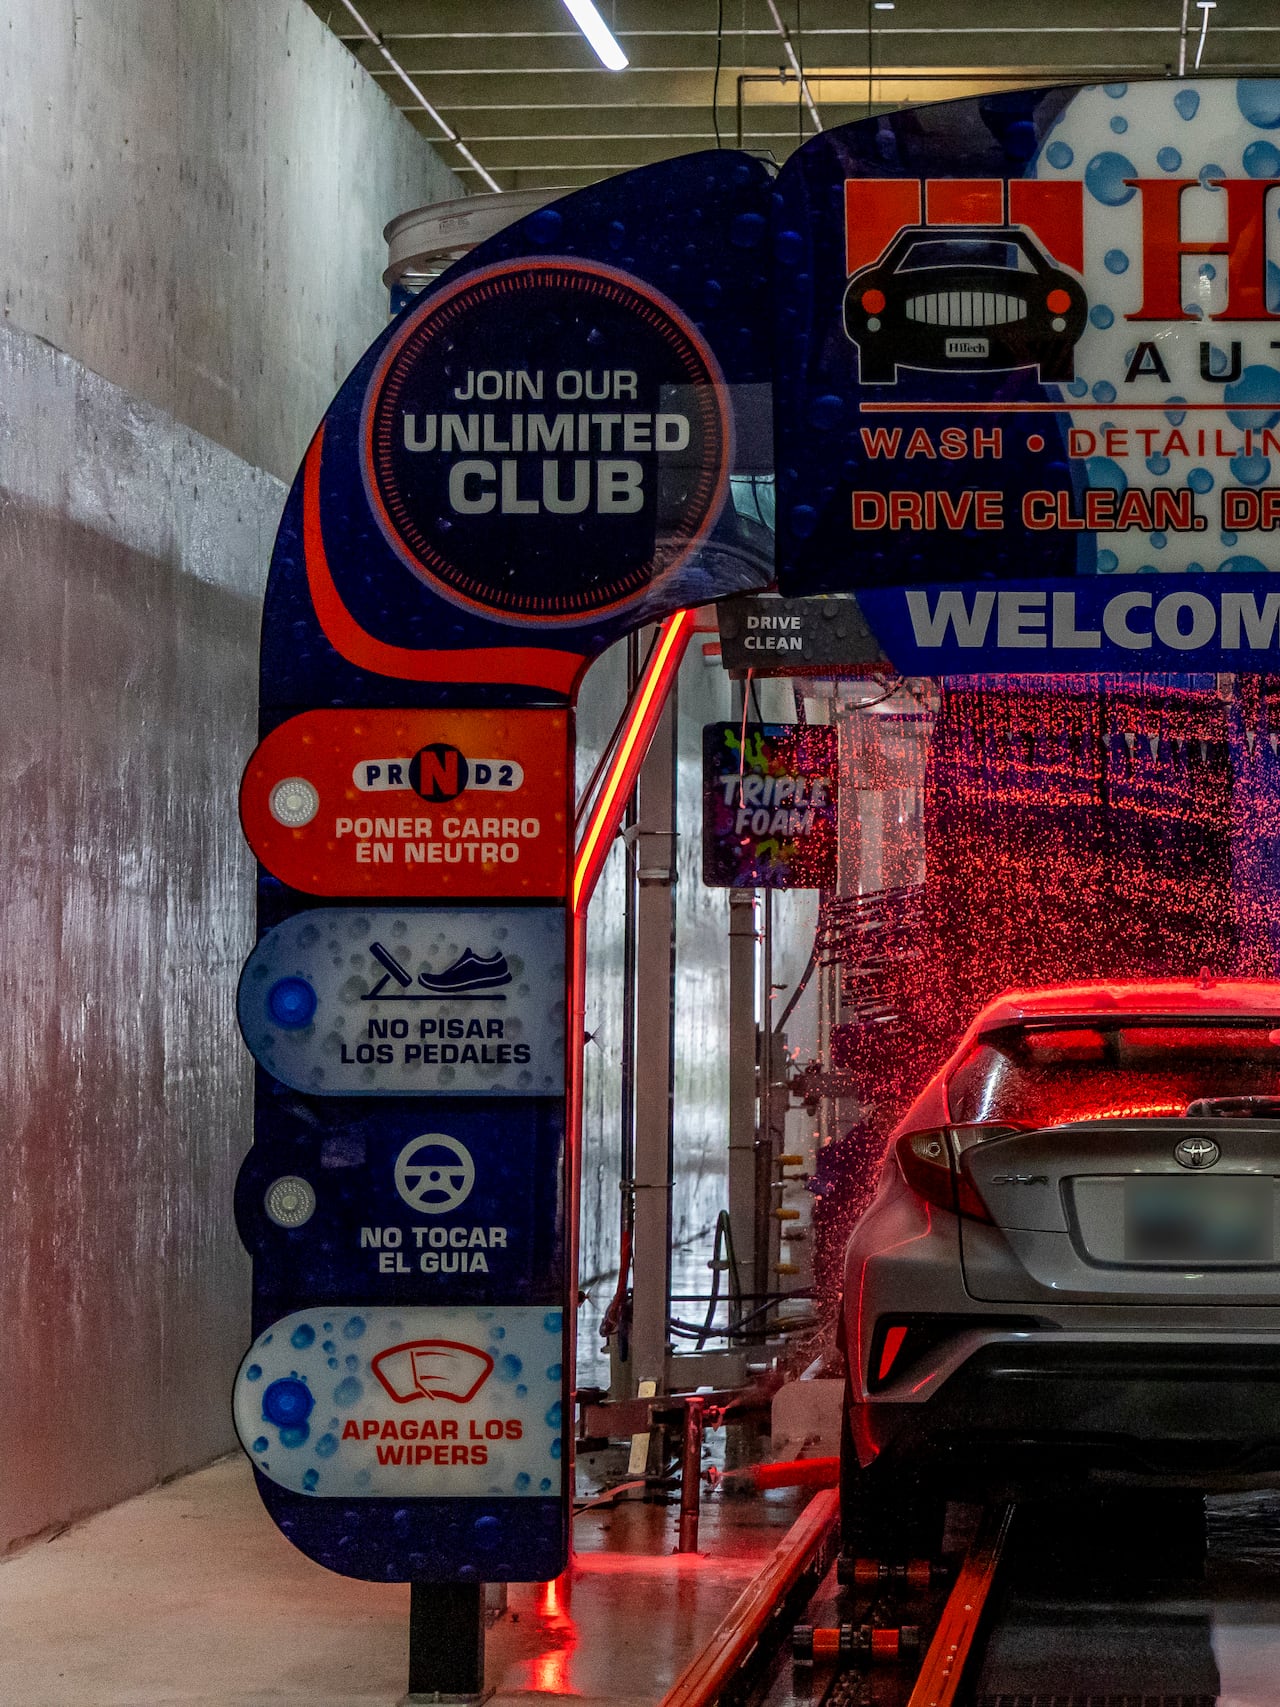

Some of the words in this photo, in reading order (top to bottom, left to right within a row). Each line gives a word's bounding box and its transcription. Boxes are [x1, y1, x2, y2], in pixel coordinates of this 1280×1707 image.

[949, 342, 986, 353] HiTech
[454, 370, 543, 400] JOIN
[557, 370, 638, 400] OUR
[404, 414, 690, 452] UNLIMITED
[860, 428, 1003, 459] WASH
[449, 460, 644, 514] CLUB
[851, 490, 1004, 530] DRIVE
[1021, 488, 1207, 531] CLEAN.
[747, 616, 801, 631] DRIVE
[743, 636, 803, 650] CLEAN
[720, 773, 831, 807] TRIPLE
[335, 817, 433, 839] PONER
[442, 817, 541, 839] CARRO
[735, 808, 815, 836] FOAM
[356, 842, 394, 864] EN
[404, 842, 520, 864] NEUTRO
[368, 1018, 409, 1039] NO
[419, 1018, 504, 1039] PISAR
[340, 1043, 394, 1065] LOS
[404, 1043, 532, 1065] PEDALES
[360, 1227, 403, 1248] NO
[411, 1227, 508, 1248] TOCAR
[378, 1252, 411, 1273] EL
[420, 1252, 489, 1273] GUIA
[341, 1419, 459, 1440] APAGAR
[469, 1419, 523, 1440] LOS
[375, 1445, 489, 1466] WIPERS
